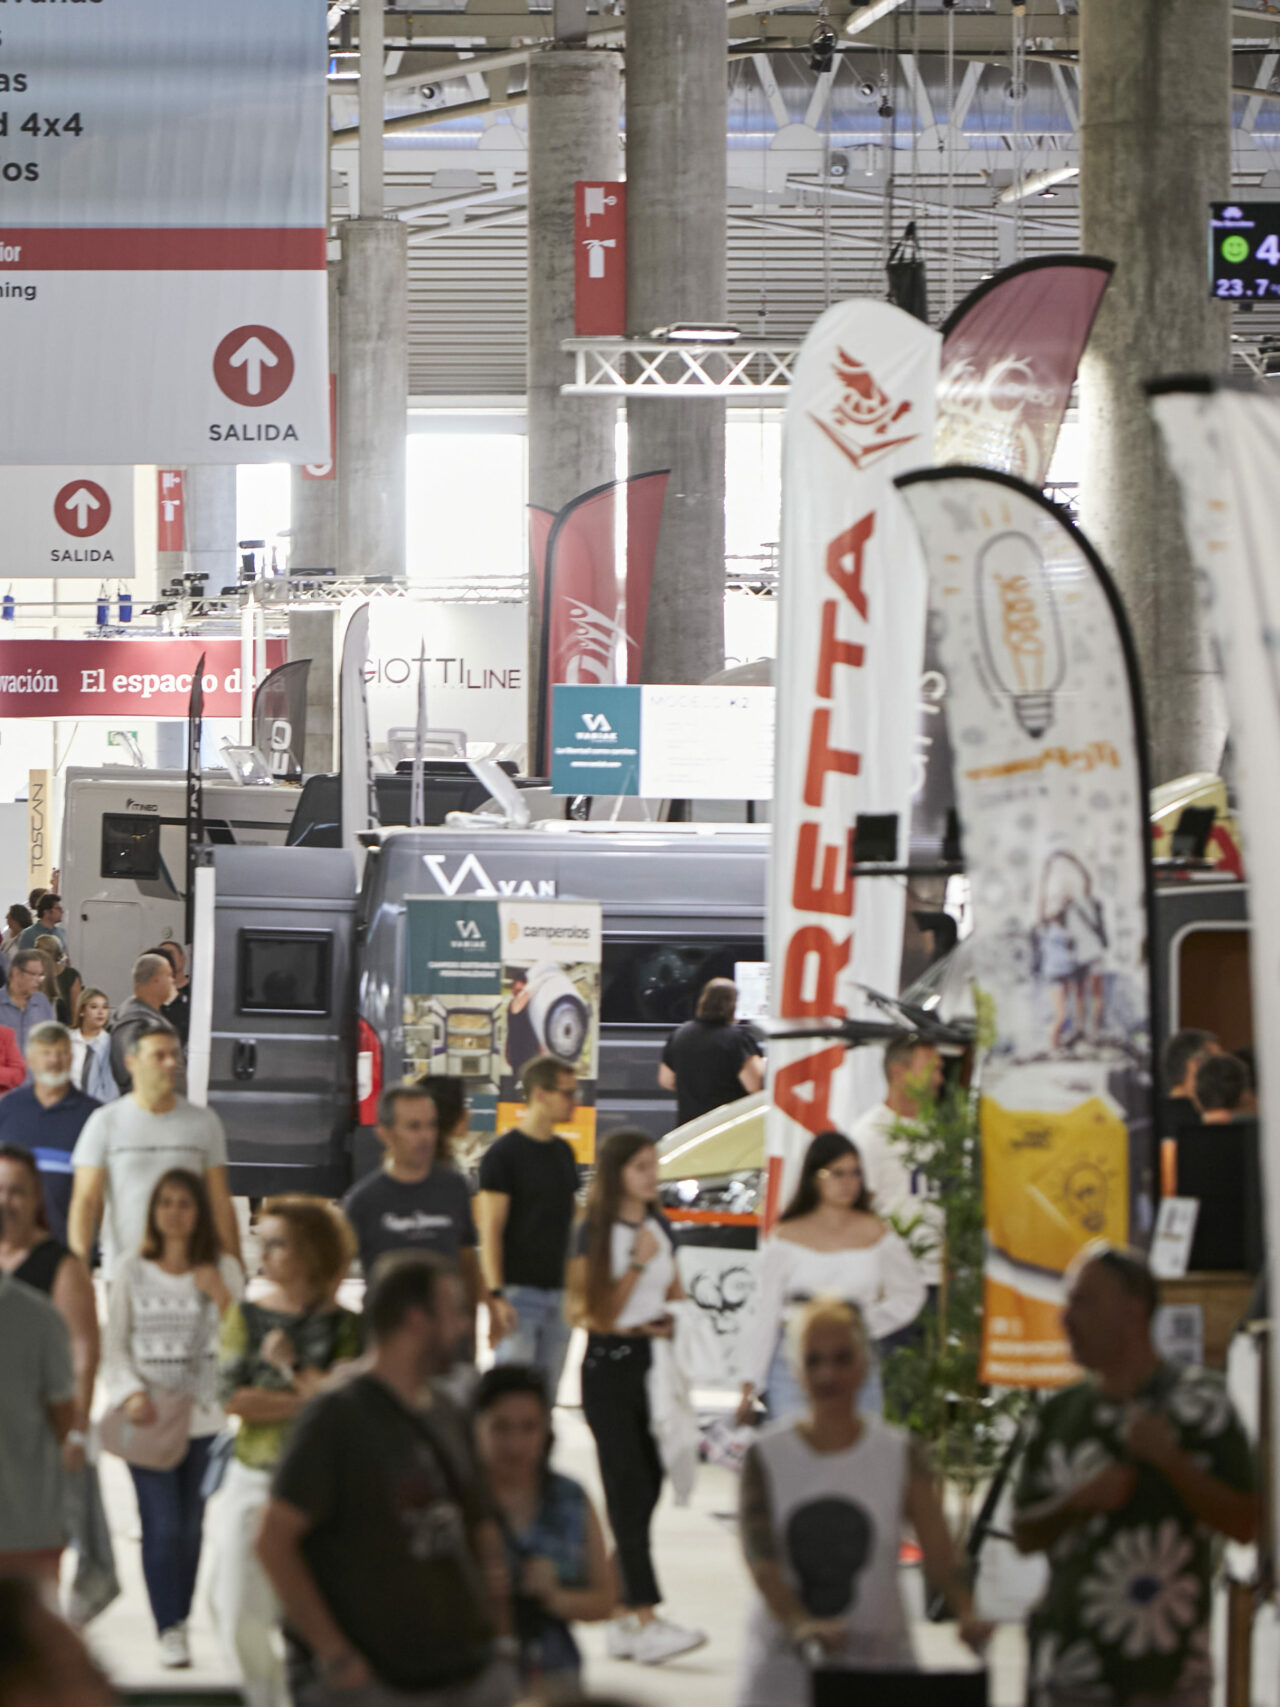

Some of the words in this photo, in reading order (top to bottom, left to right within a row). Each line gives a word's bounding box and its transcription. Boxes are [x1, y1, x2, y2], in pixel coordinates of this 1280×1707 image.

[20, 112, 84, 137] 4x4
[208, 424, 299, 441] SALIDA
[50, 549, 114, 562] SALIDA
[80, 669, 106, 693] El
[112, 671, 218, 697] espaco
[760, 510, 876, 1242] ARETTA
